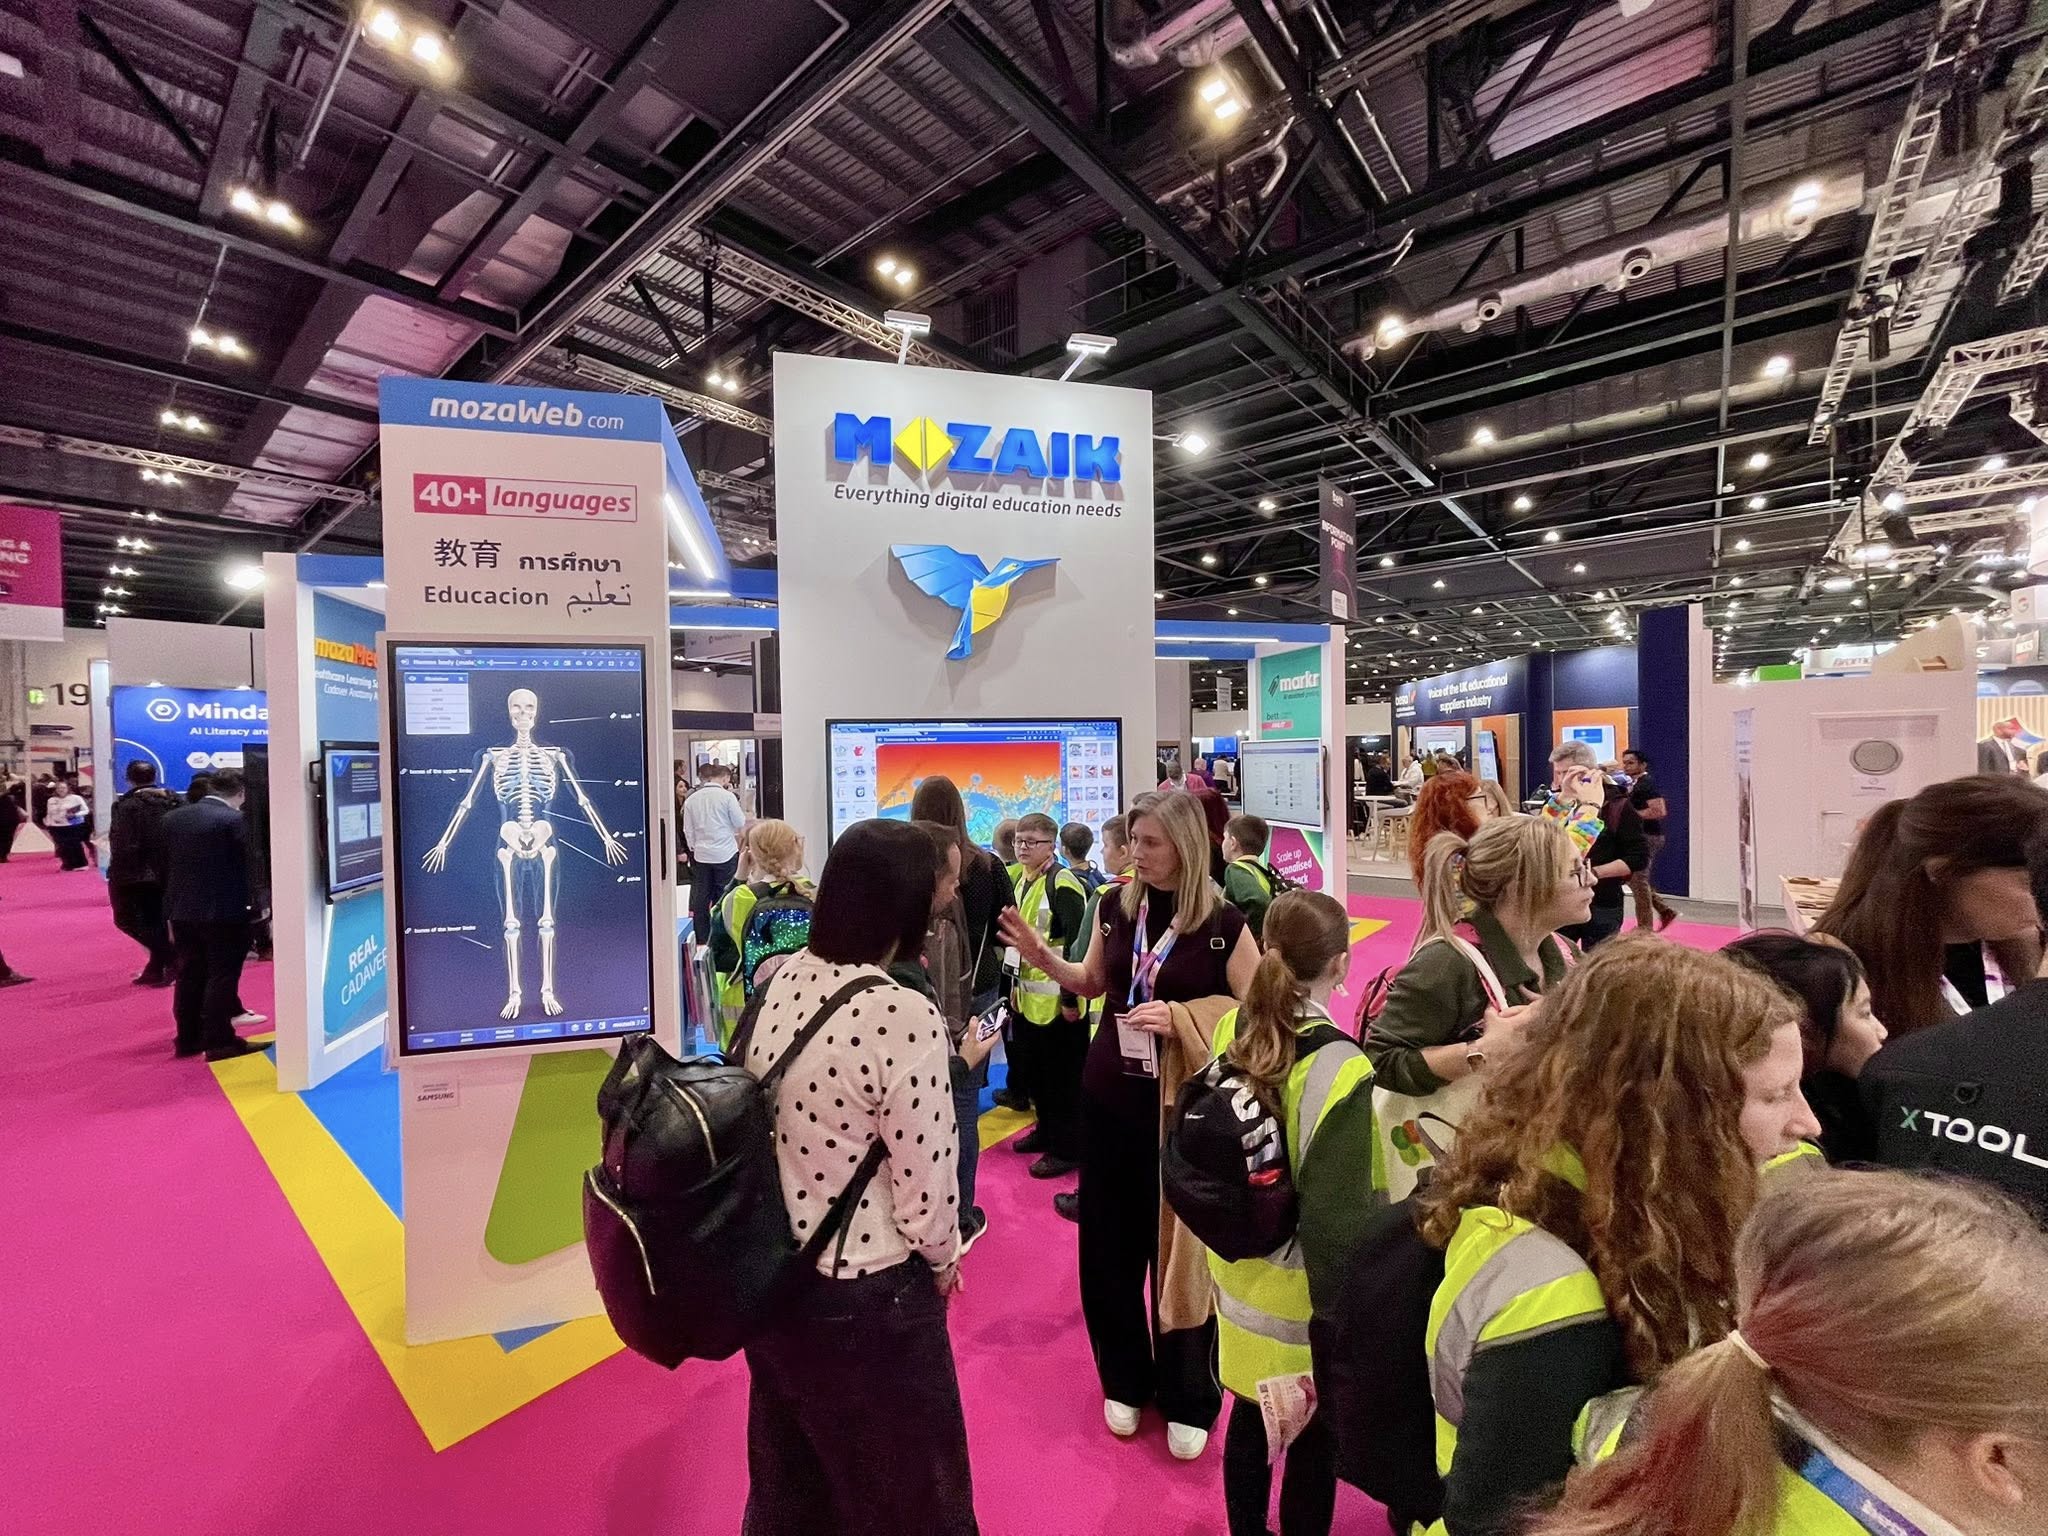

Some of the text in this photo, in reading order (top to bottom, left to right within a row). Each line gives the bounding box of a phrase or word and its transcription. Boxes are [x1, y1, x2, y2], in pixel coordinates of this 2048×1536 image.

[429, 397, 583, 427] mozaWeb
[418, 481, 632, 516] 40+ languages
[834, 484, 1122, 518] Everything digital education needs
[434, 538, 502, 569] 教育
[519, 551, 621, 573] การศึกษา
[424, 586, 549, 606] Educacion
[566, 579, 632, 618] تعليم
[314, 637, 378, 669] mozaMe
[1280, 671, 1321, 691] markr
[1428, 688, 1443, 699] Voice
[1449, 685, 1459, 695] the
[1459, 682, 1468, 693] UK
[1468, 672, 1508, 692] educational
[1439, 695, 1492, 714] suppliers industry
[189, 727, 202, 735] AI
[204, 727, 250, 737] Literacy
[348, 934, 378, 973] REAL
[417, 1091, 455, 1102] SAMSUNG
